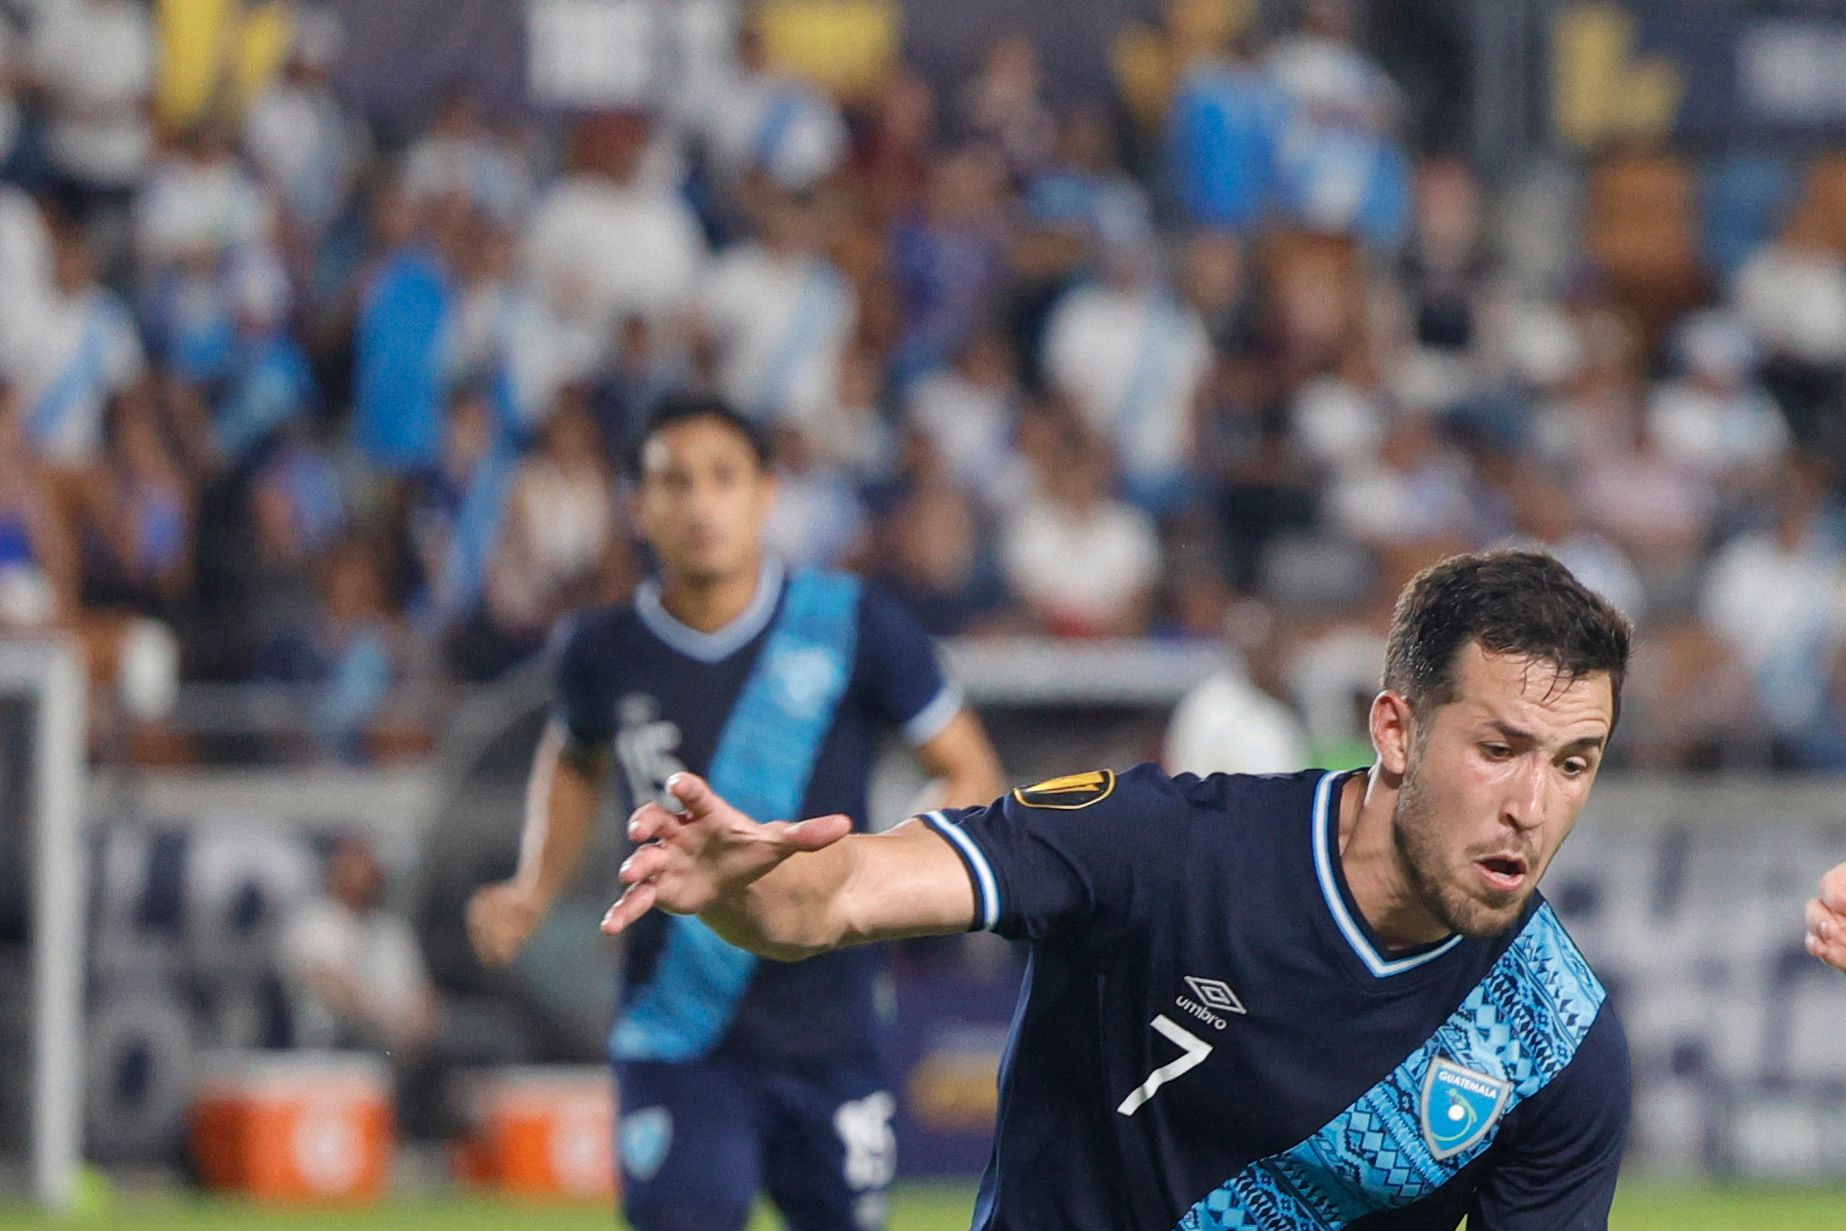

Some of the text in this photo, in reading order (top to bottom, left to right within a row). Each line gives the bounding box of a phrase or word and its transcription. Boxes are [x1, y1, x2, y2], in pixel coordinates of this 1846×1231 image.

[1175, 995, 1228, 1030] umbro
[1117, 1014, 1214, 1116] 7
[1438, 1069, 1498, 1099] GUATEMALA
